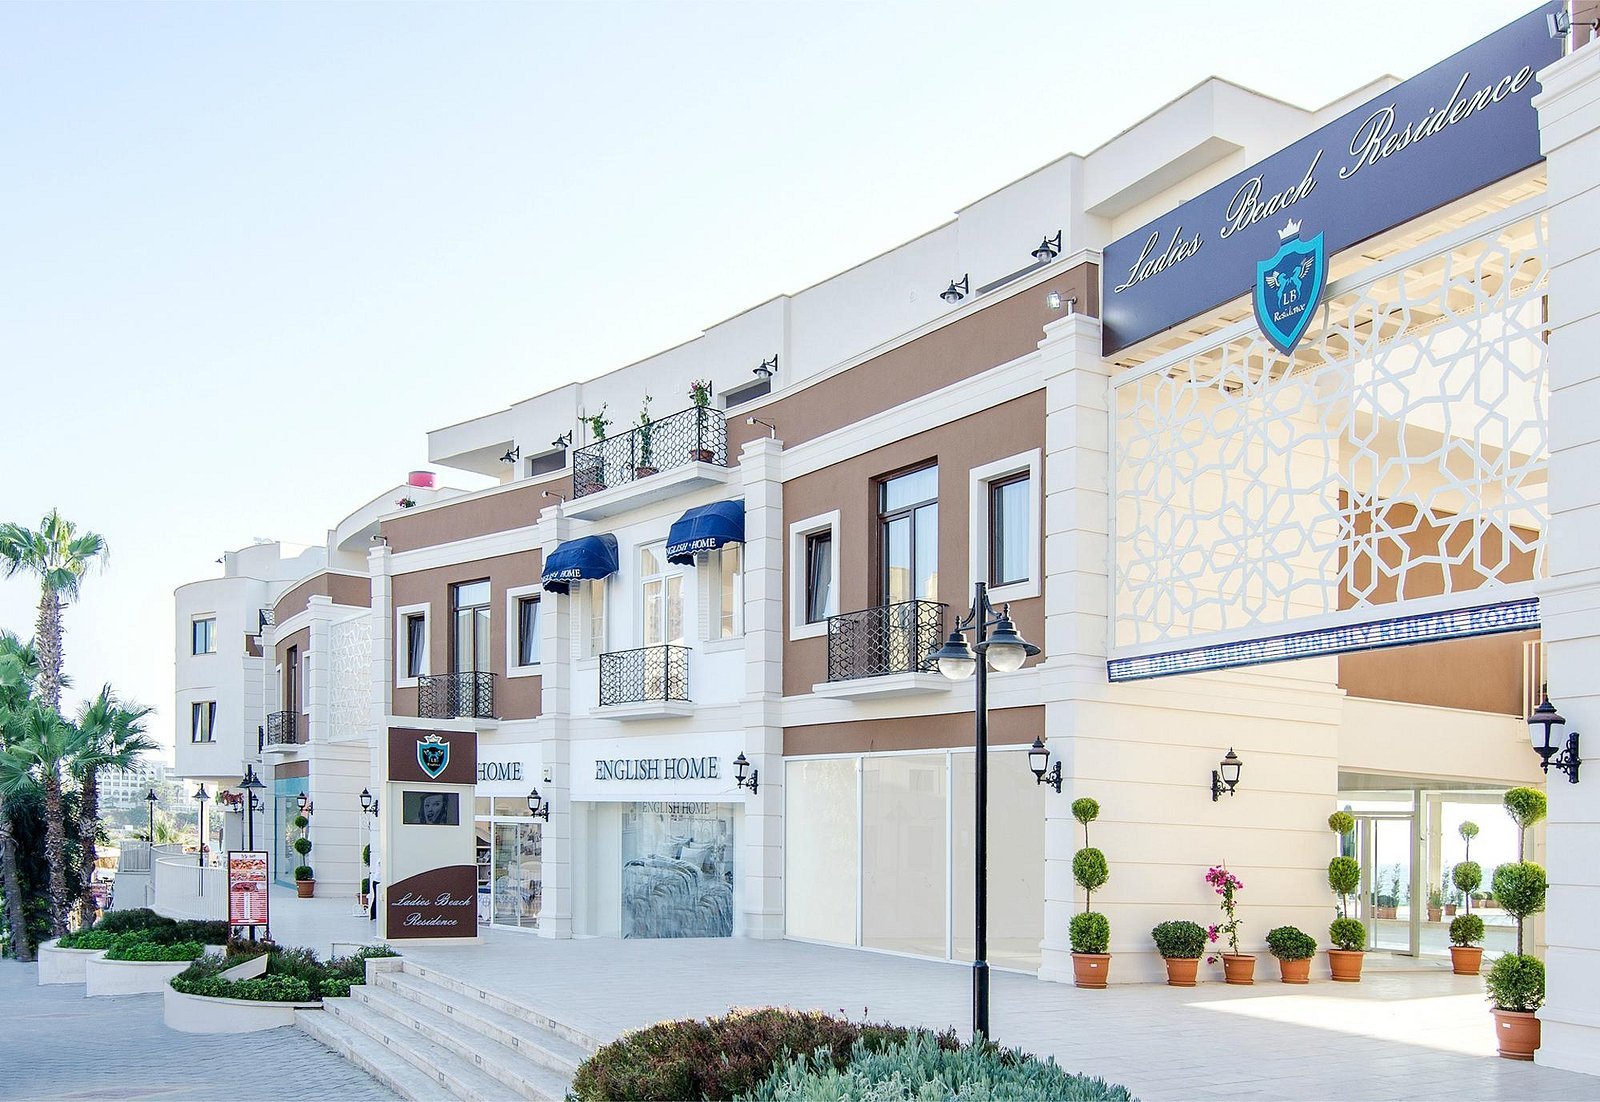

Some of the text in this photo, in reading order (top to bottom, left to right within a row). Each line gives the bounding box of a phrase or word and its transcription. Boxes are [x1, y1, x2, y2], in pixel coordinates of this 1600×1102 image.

[1114, 65, 1535, 294] Ladies Beach Residence
[691, 537, 717, 550] HOME
[560, 568, 581, 578] HOME
[1284, 626, 1370, 653] MONTHLY
[1379, 613, 1459, 641] RENTAL
[477, 762, 522, 781] HOME
[595, 756, 719, 781] ENGLISH HOME
[642, 801, 710, 815] ENGLISH HOME
[391, 892, 473, 906] Ladies Beach
[402, 912, 459, 926] Residence
